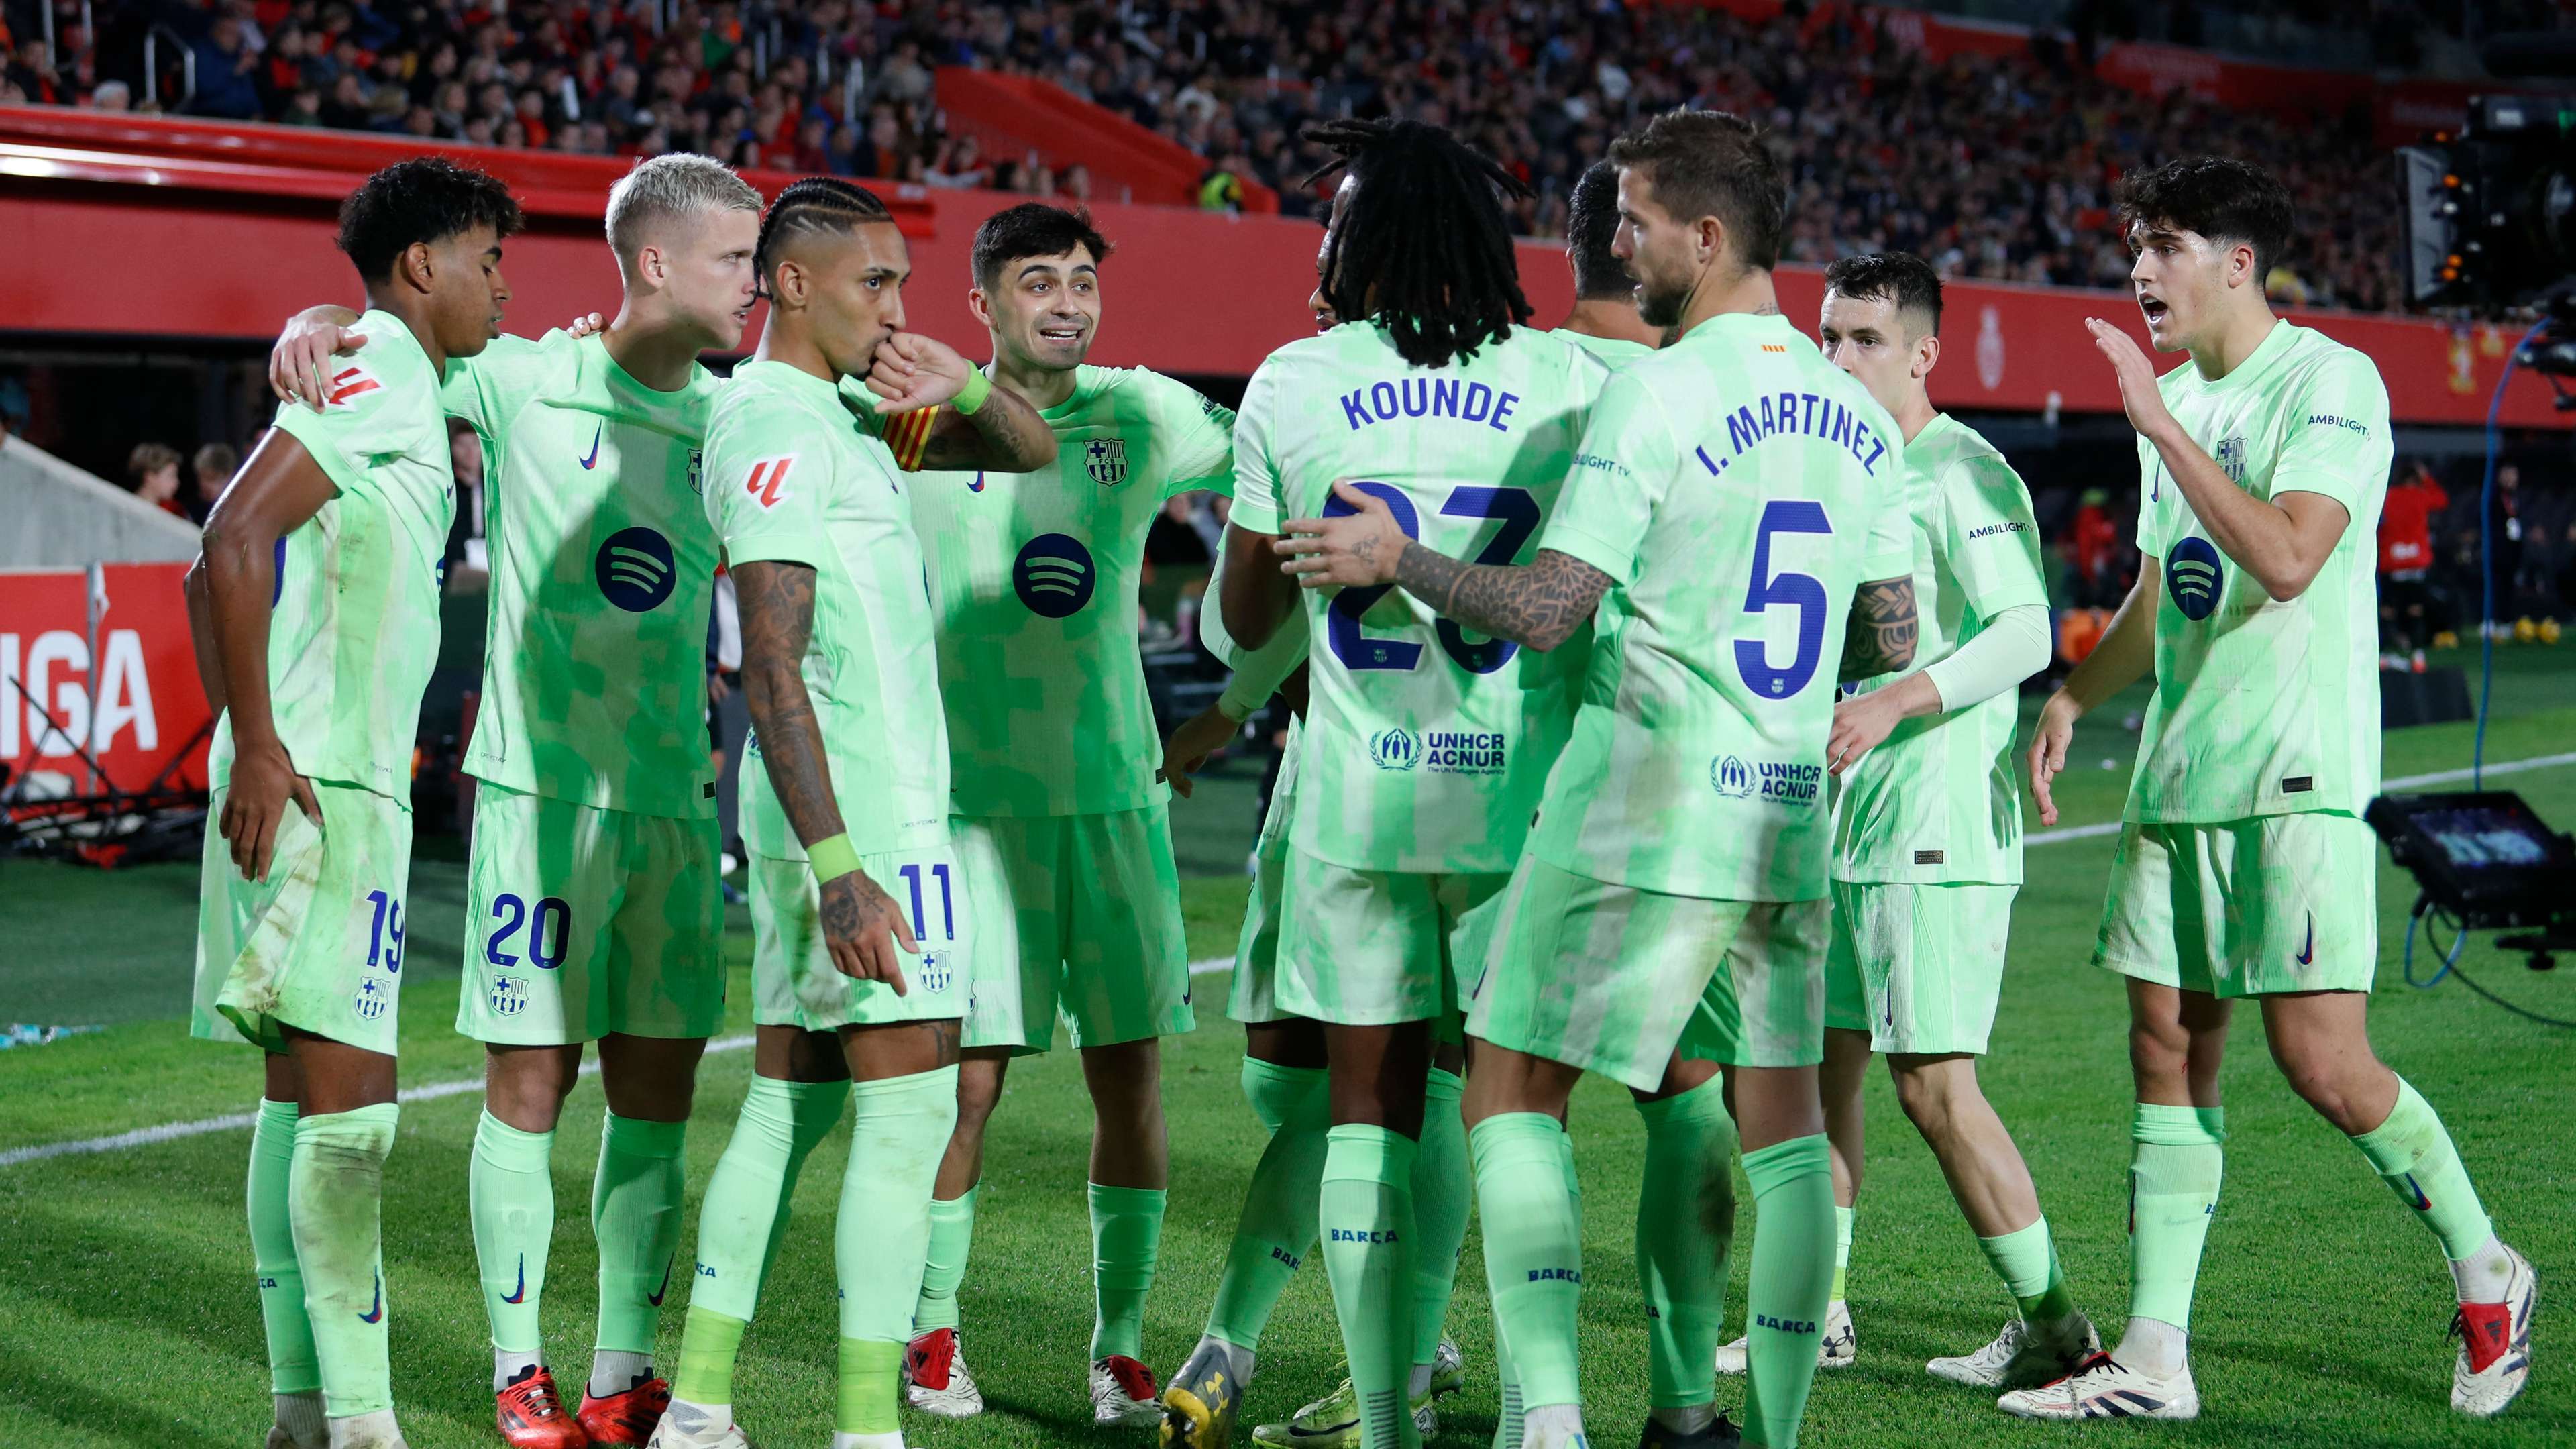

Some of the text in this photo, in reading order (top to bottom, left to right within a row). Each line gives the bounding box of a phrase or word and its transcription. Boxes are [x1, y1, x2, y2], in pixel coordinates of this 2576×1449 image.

[1340, 378, 1520, 431] KOUNDE
[1695, 392, 1885, 477] I. MARTINEZ
[2308, 415, 2367, 435] AMBILIGHT
[1969, 522, 2027, 540] AMBILIGHT
[1734, 501, 1833, 699] 5
[1428, 733, 1505, 749] UNHCR
[1427, 750, 1505, 767] ACNUR
[1759, 763, 1822, 782] UNHCR
[1761, 779, 1817, 799] ACNUR
[899, 864, 954, 941] 11
[366, 890, 405, 973] 19
[486, 893, 572, 969] 20
[1332, 1229, 1399, 1244] BARÇA
[1757, 1314, 1816, 1334] BARÇA
